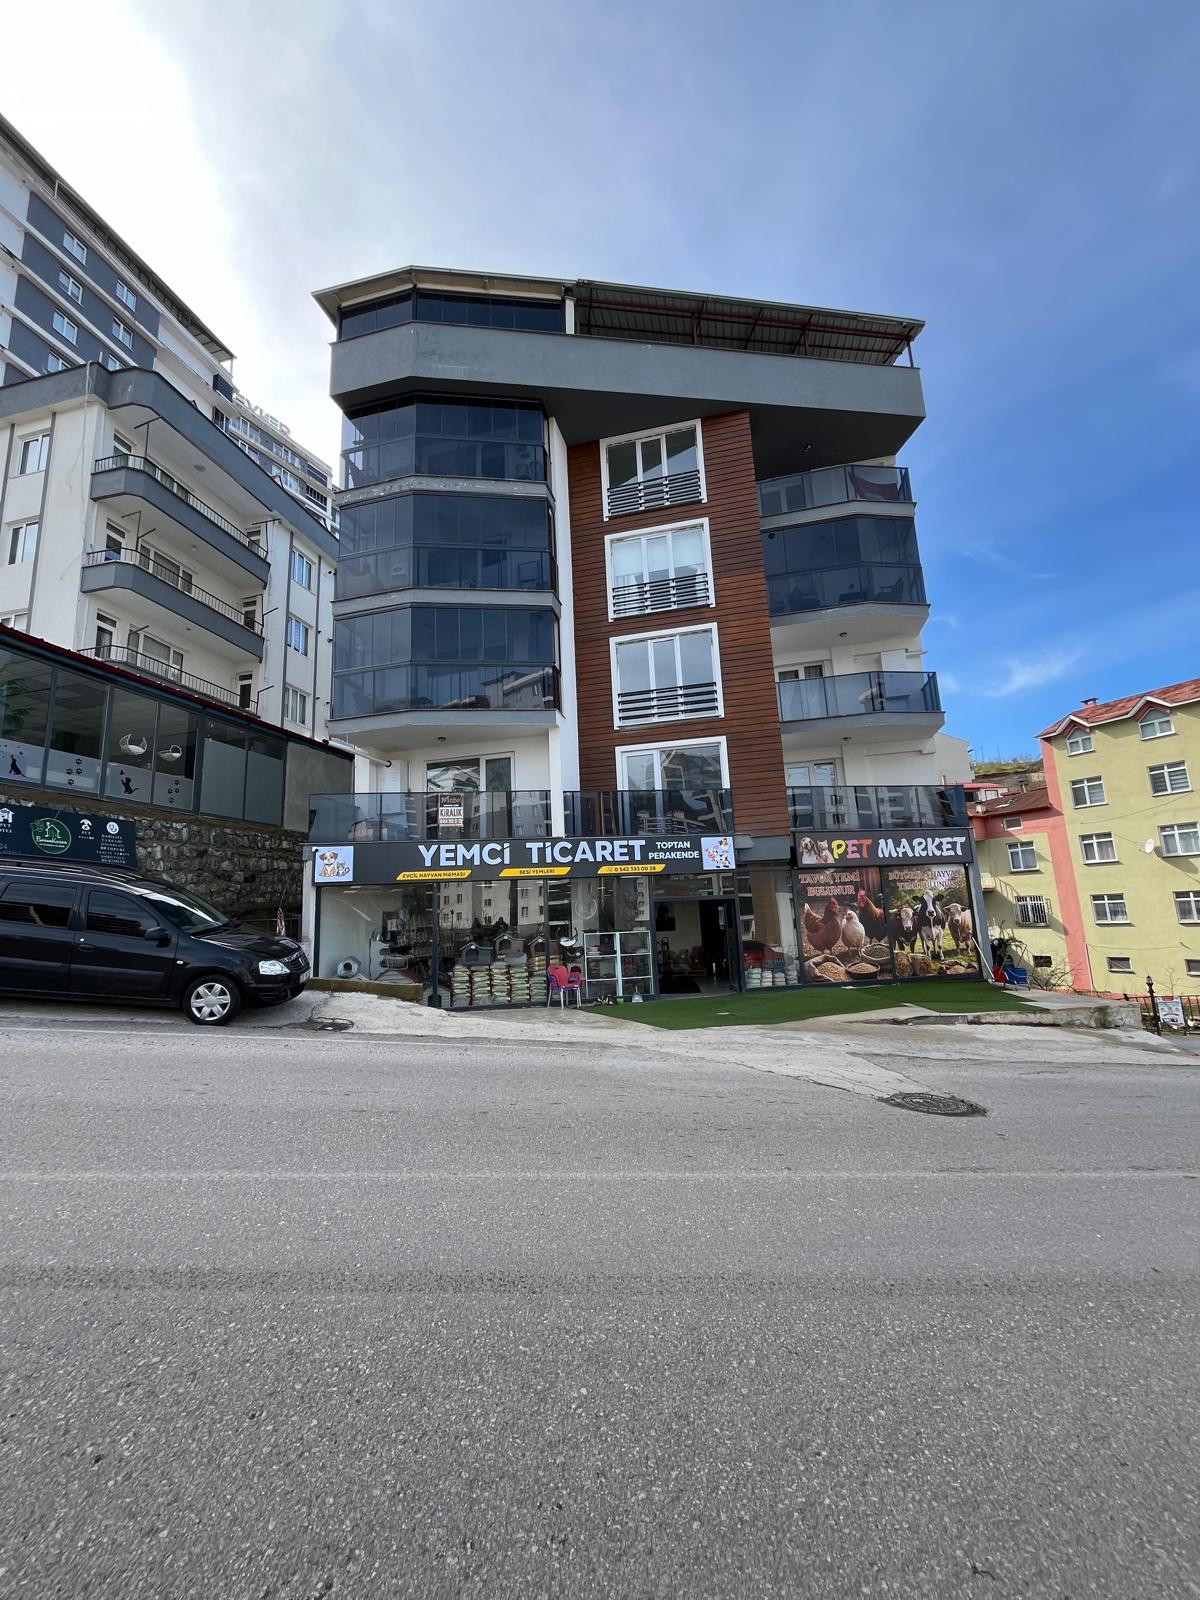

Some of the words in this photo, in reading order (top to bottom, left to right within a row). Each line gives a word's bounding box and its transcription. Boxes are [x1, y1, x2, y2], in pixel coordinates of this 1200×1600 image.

[655, 841, 690, 849] TOPTAN
[831, 838, 872, 859] PET
[877, 836, 966, 858] MARKET
[648, 851, 700, 860] PERAKENDE
